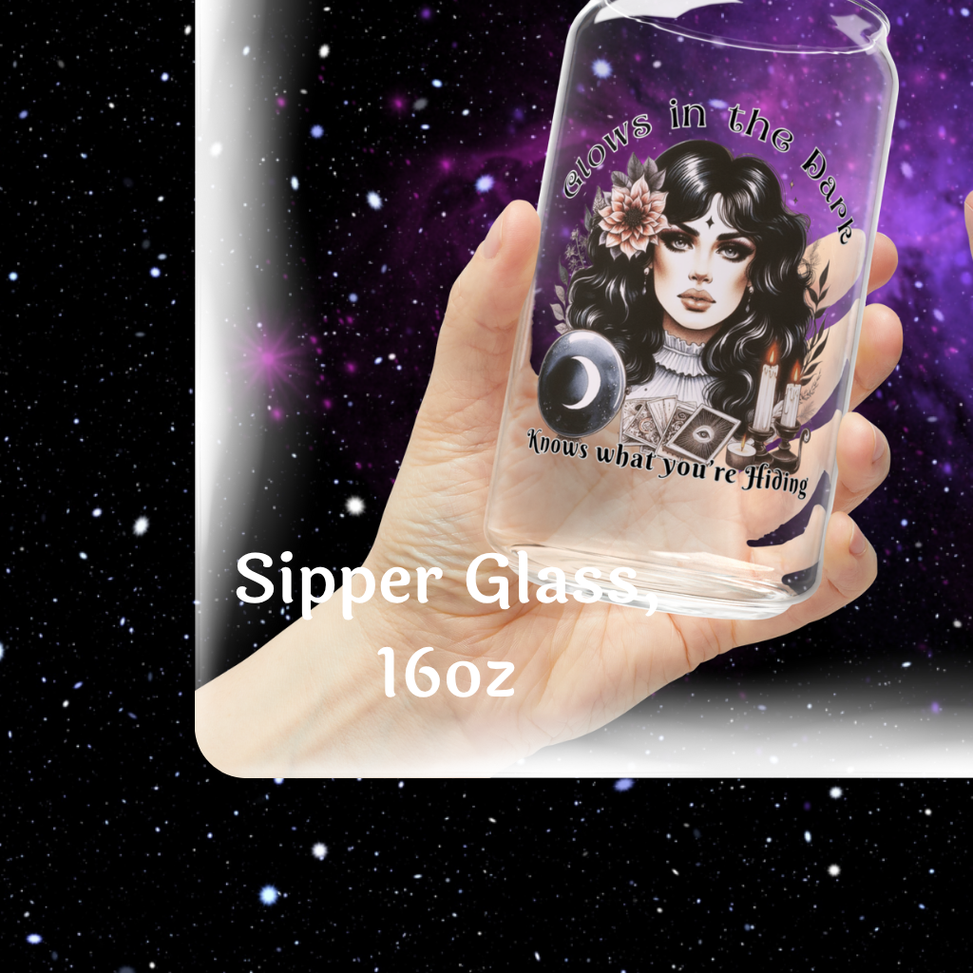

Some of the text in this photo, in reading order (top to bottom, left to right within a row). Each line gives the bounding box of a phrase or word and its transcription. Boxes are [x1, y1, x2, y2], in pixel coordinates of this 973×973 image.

[563, 98, 855, 246] Glows in the Dark
[526, 427, 589, 460] Knows
[596, 445, 654, 472] what
[741, 462, 810, 499] Hiding
